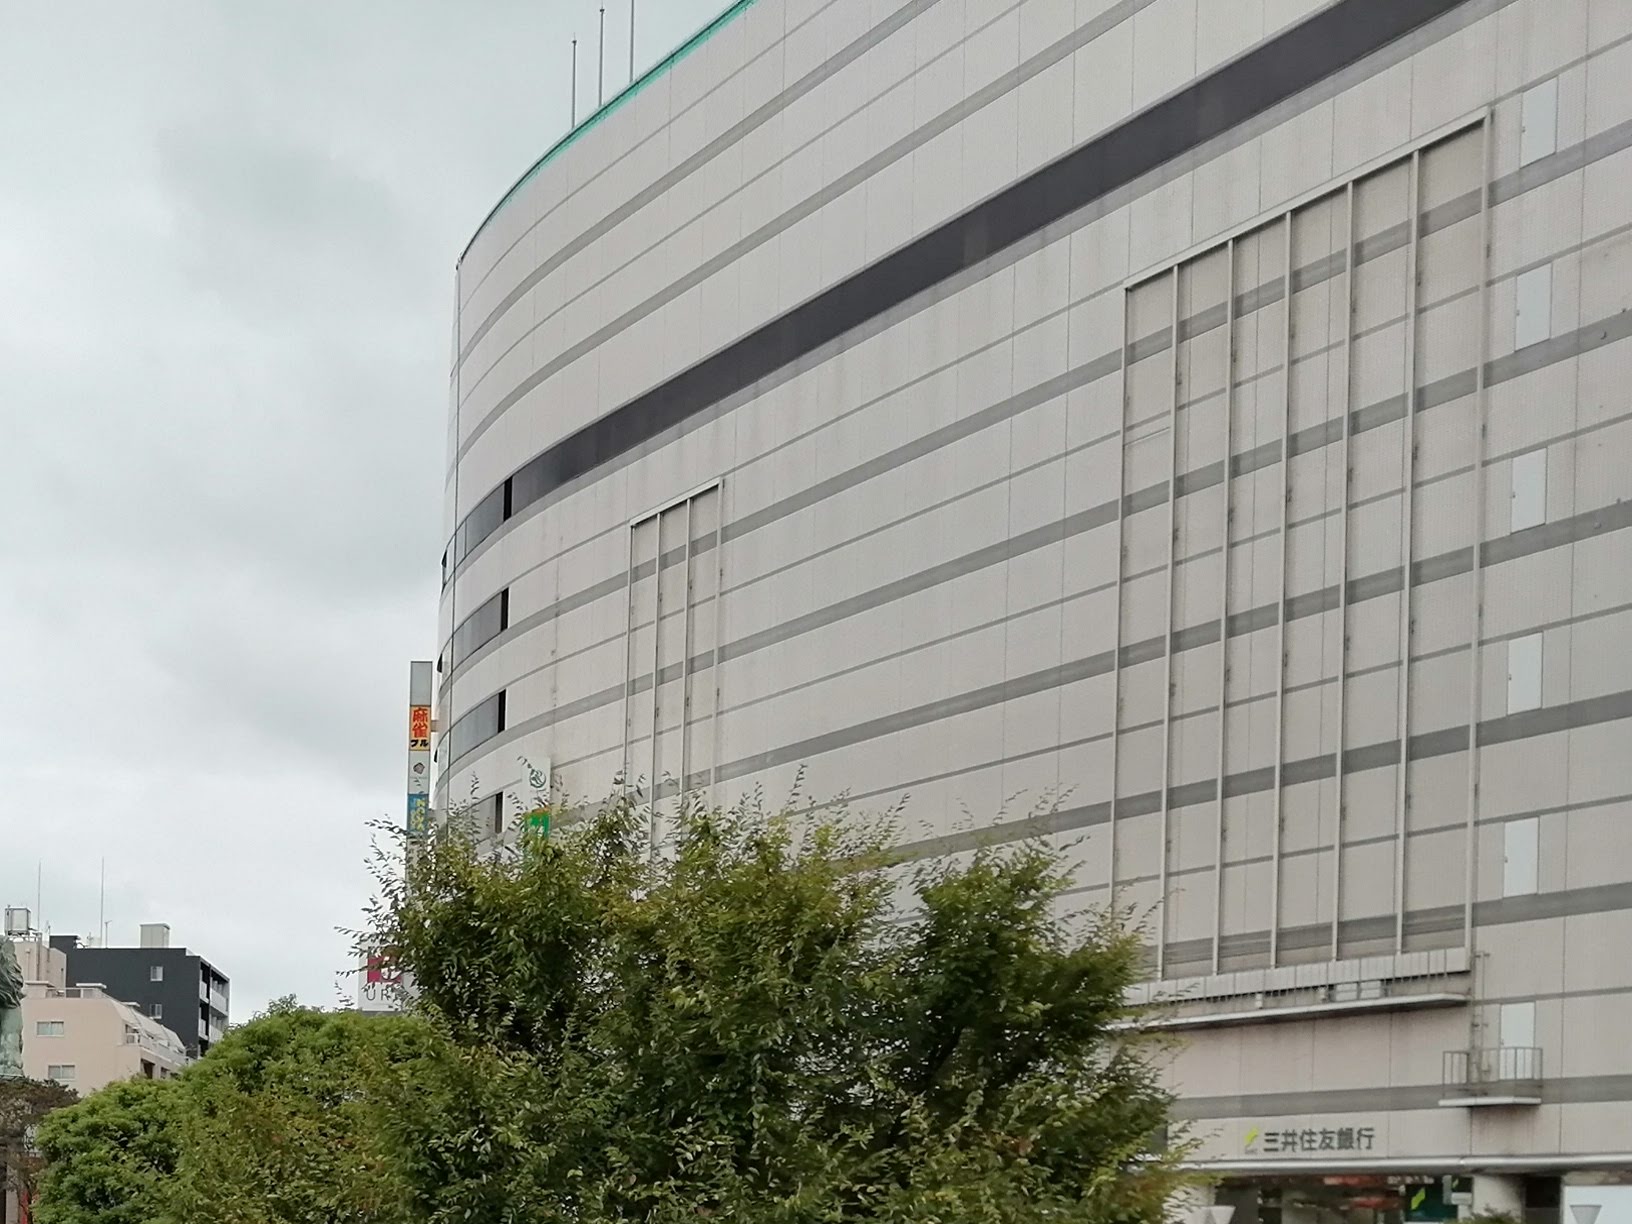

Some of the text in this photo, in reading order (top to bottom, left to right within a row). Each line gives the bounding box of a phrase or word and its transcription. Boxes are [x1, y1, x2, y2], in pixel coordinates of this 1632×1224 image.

[1263, 1127, 1376, 1152] 三井住友銀行
